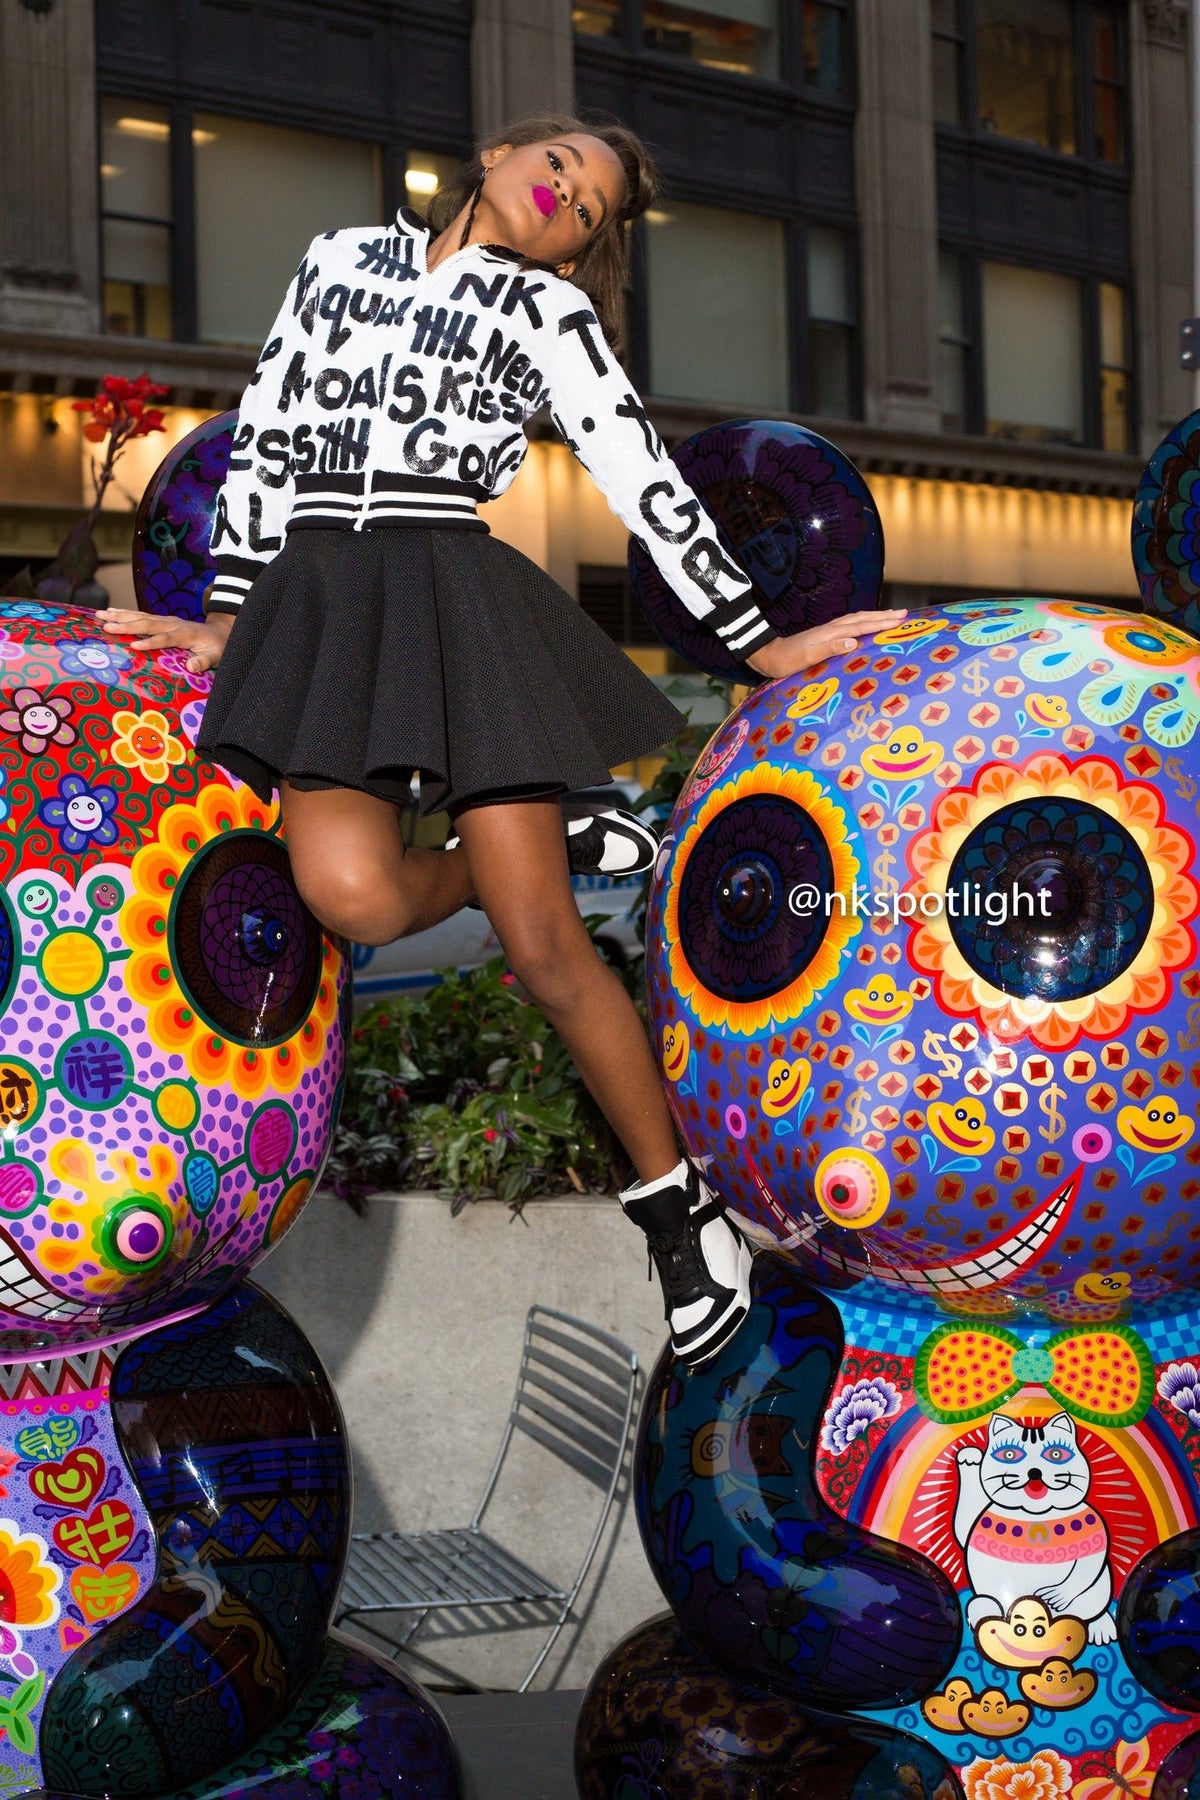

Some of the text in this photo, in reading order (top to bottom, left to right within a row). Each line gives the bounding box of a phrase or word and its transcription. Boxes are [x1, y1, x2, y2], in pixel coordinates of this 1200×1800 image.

[449, 273, 547, 330] NK
[49, 933, 97, 987] 吉
[64, 1041, 124, 1099] 祥
